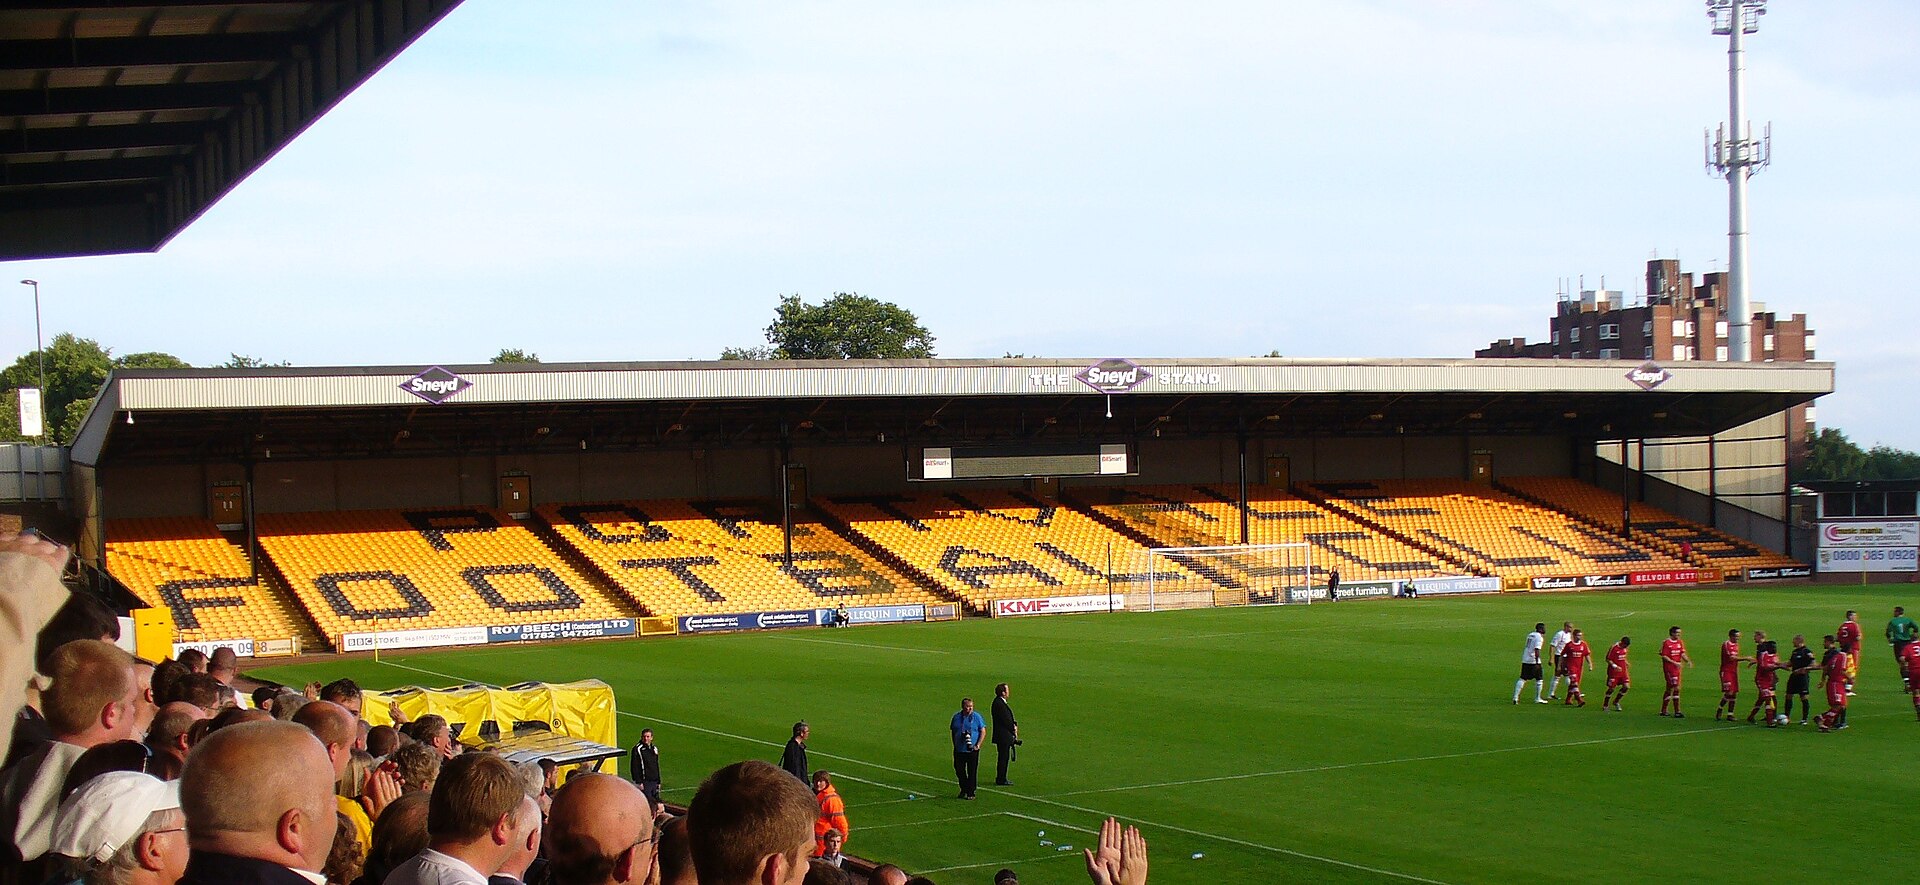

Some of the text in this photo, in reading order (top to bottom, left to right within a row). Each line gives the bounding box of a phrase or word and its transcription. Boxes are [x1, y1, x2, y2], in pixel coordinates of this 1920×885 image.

[1029, 366, 1221, 387] THE Sneyd STAND
[1632, 369, 1664, 384] Sneyd
[411, 377, 459, 395] Sneyd
[1833, 550, 1861, 561] 0800
[1888, 549, 1917, 561] 0928
[1635, 573, 1671, 582] BELVOIR
[1355, 585, 1389, 597] furniture
[1454, 580, 1493, 590] PROPERTY
[1000, 600, 1050, 613] KMF
[491, 625, 521, 635] ROY
[522, 622, 571, 634] BEECH
[603, 619, 630, 629] LTD
[1842, 626, 1849, 638] 5
[1898, 623, 1904, 634] 1
[348, 637, 373, 647] BBC
